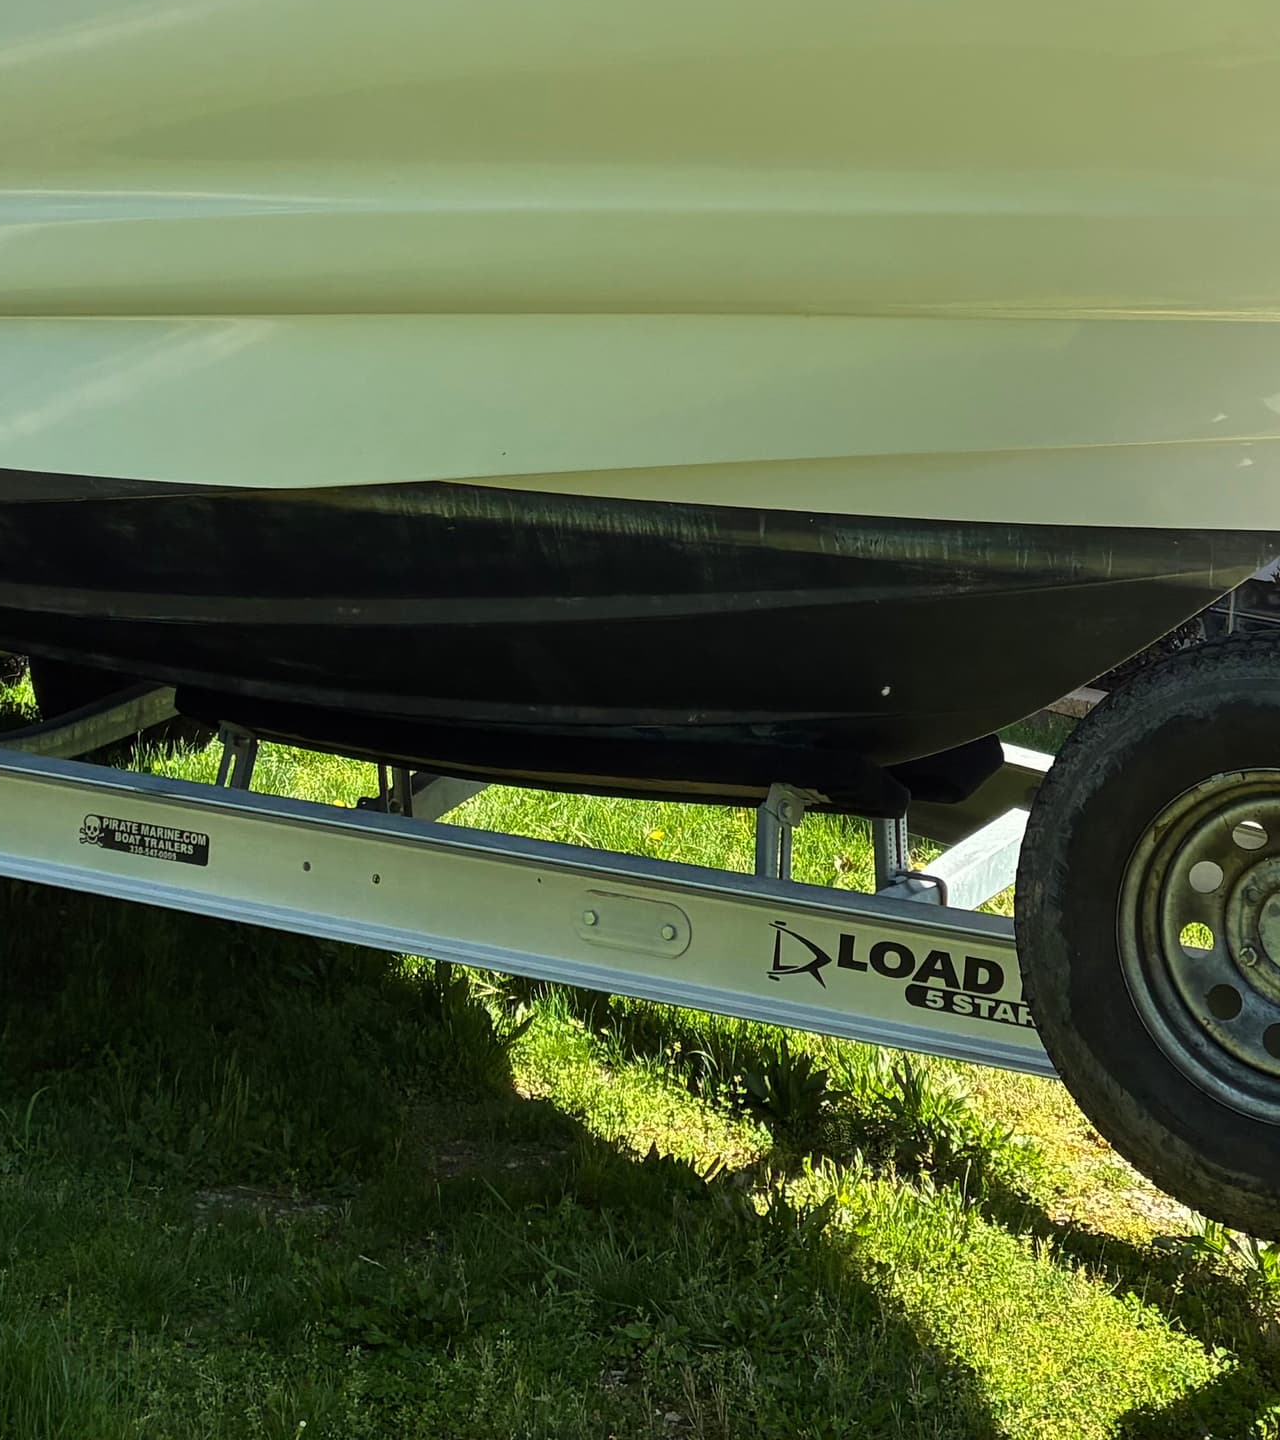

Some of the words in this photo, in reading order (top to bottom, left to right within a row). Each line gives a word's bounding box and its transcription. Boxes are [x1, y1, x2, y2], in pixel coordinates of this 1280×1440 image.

[102, 817, 139, 834] PIRATE
[140, 824, 207, 847] MARINE.COM
[114, 831, 141, 846] BOAT
[144, 836, 194, 856] TRAILERS
[837, 933, 1005, 995] LOAD
[925, 990, 944, 1009] 5
